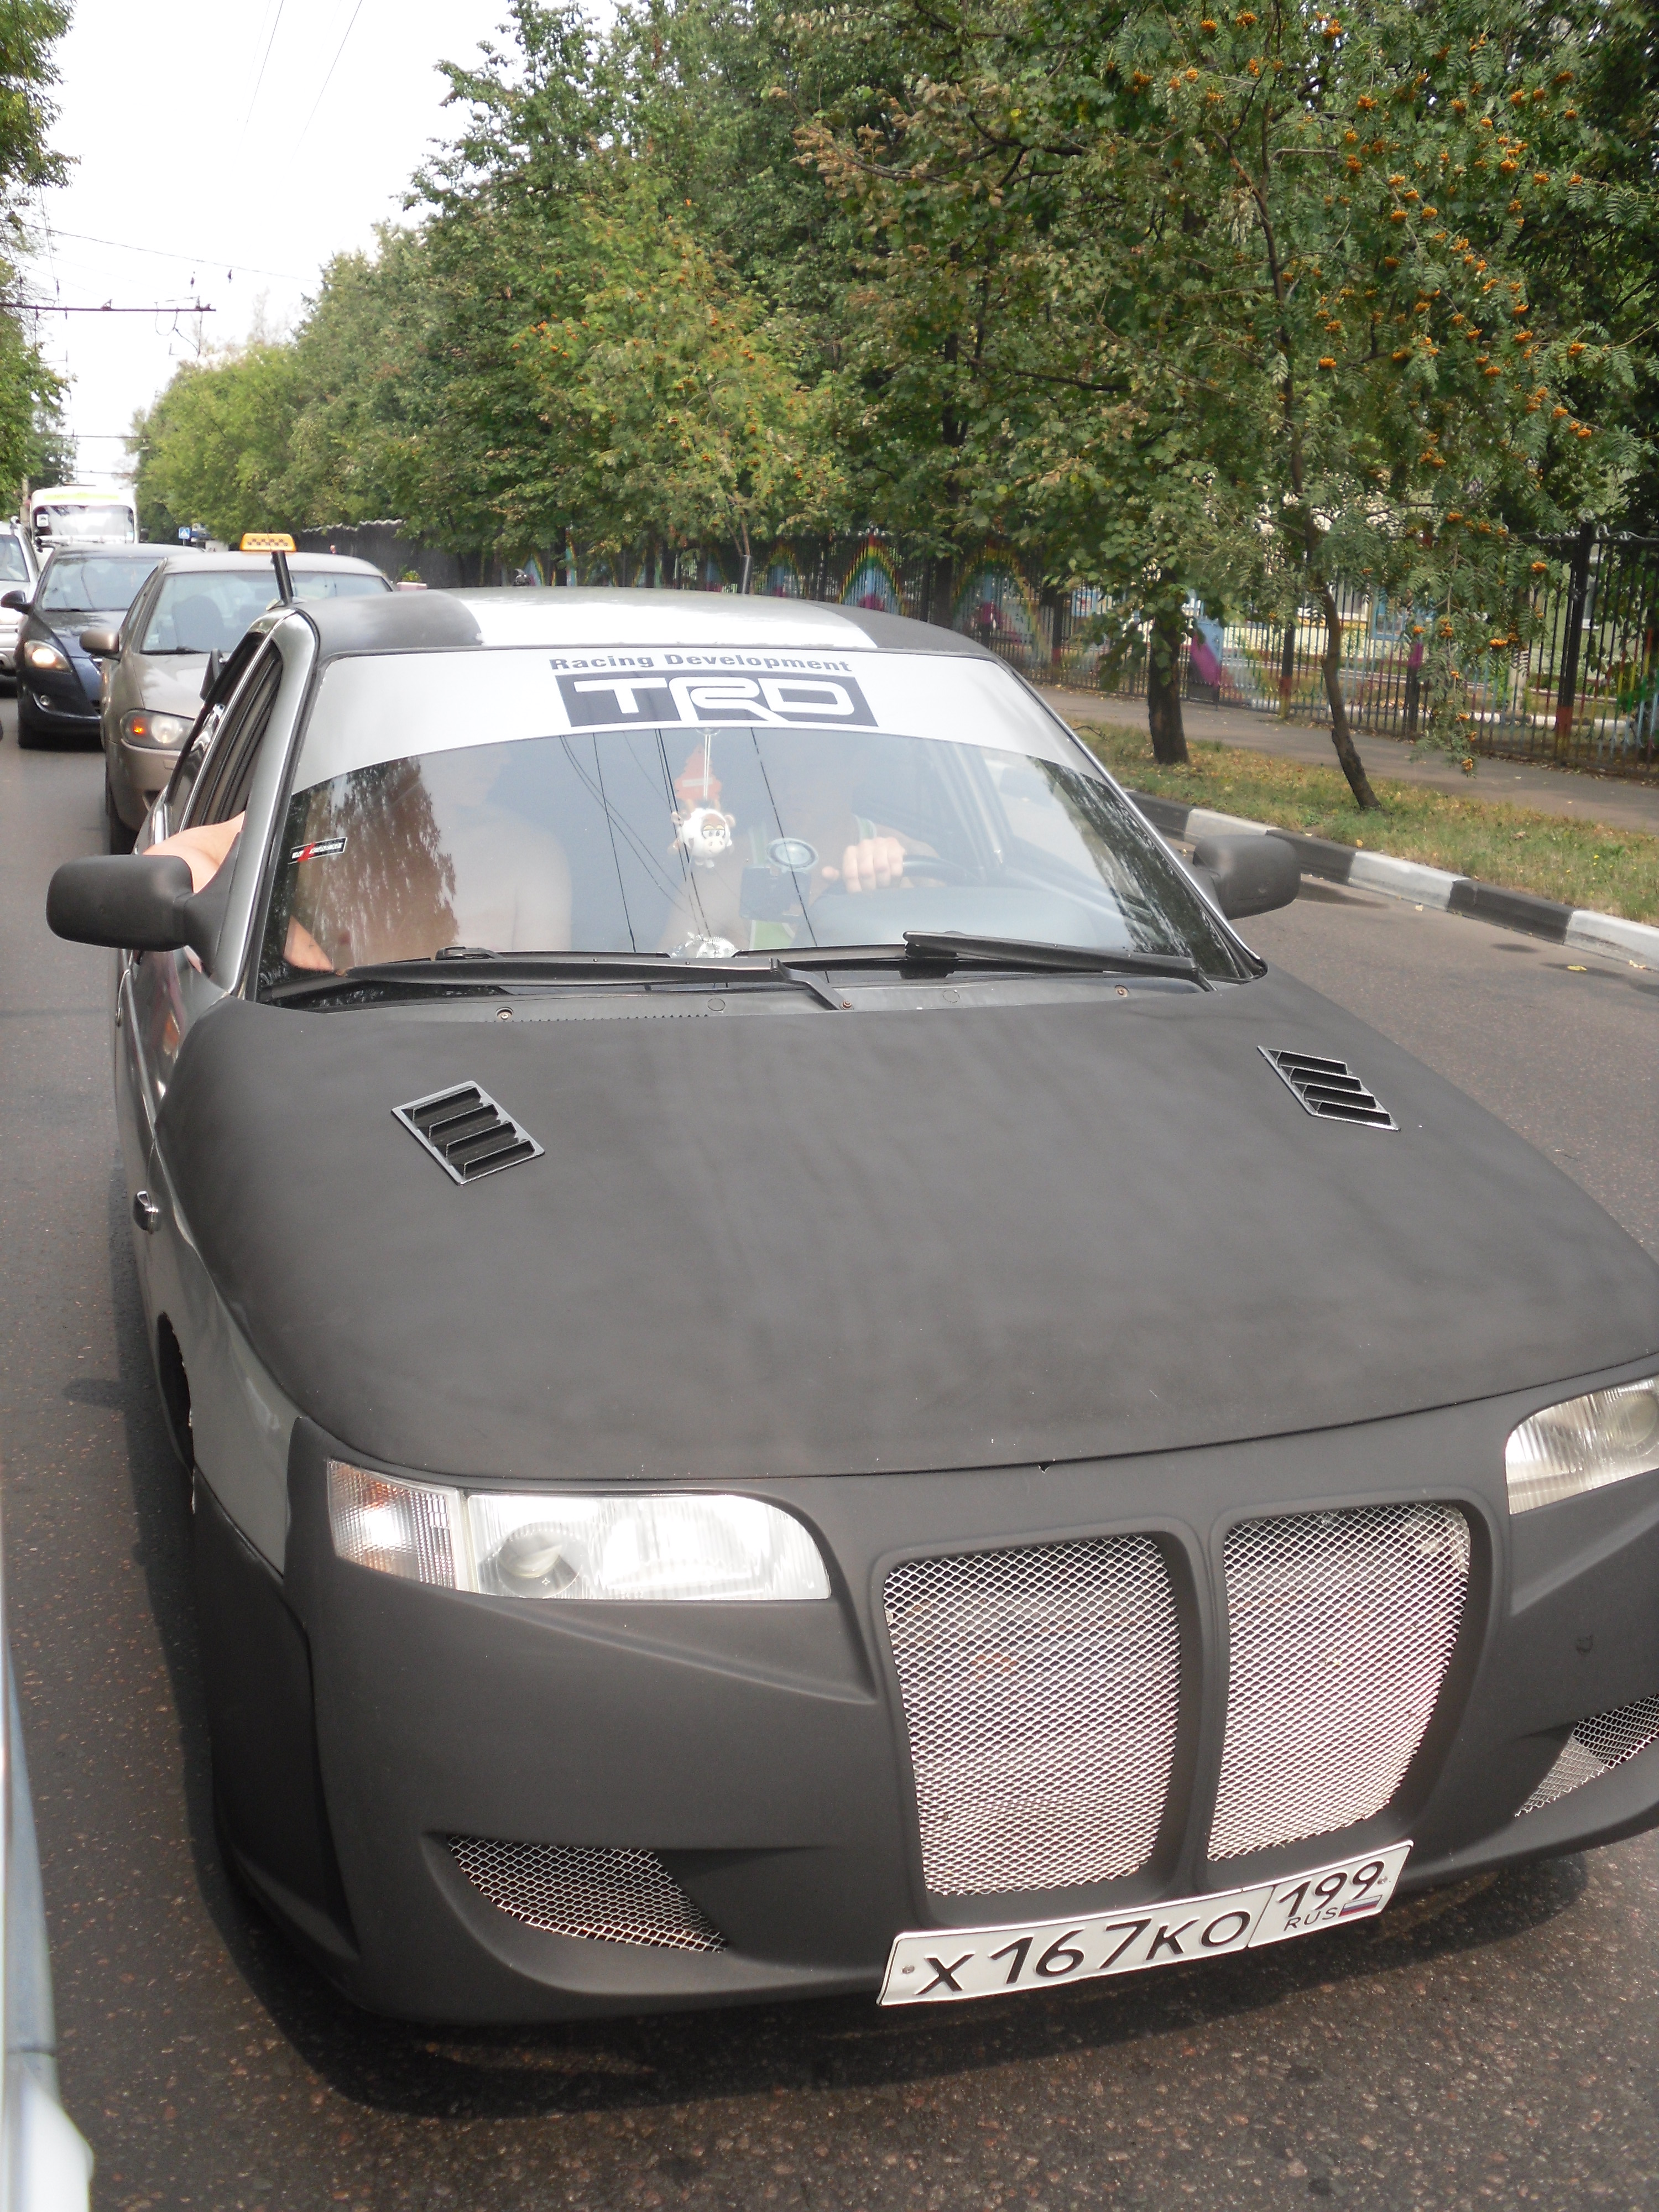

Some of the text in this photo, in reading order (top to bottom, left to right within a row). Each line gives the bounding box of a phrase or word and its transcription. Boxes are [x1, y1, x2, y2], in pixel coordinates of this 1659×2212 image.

[549, 654, 852, 672] Racing Development
[572, 676, 855, 721] TRD
[1278, 1860, 1385, 1918] 199
[1283, 1907, 1338, 1932] RUS
